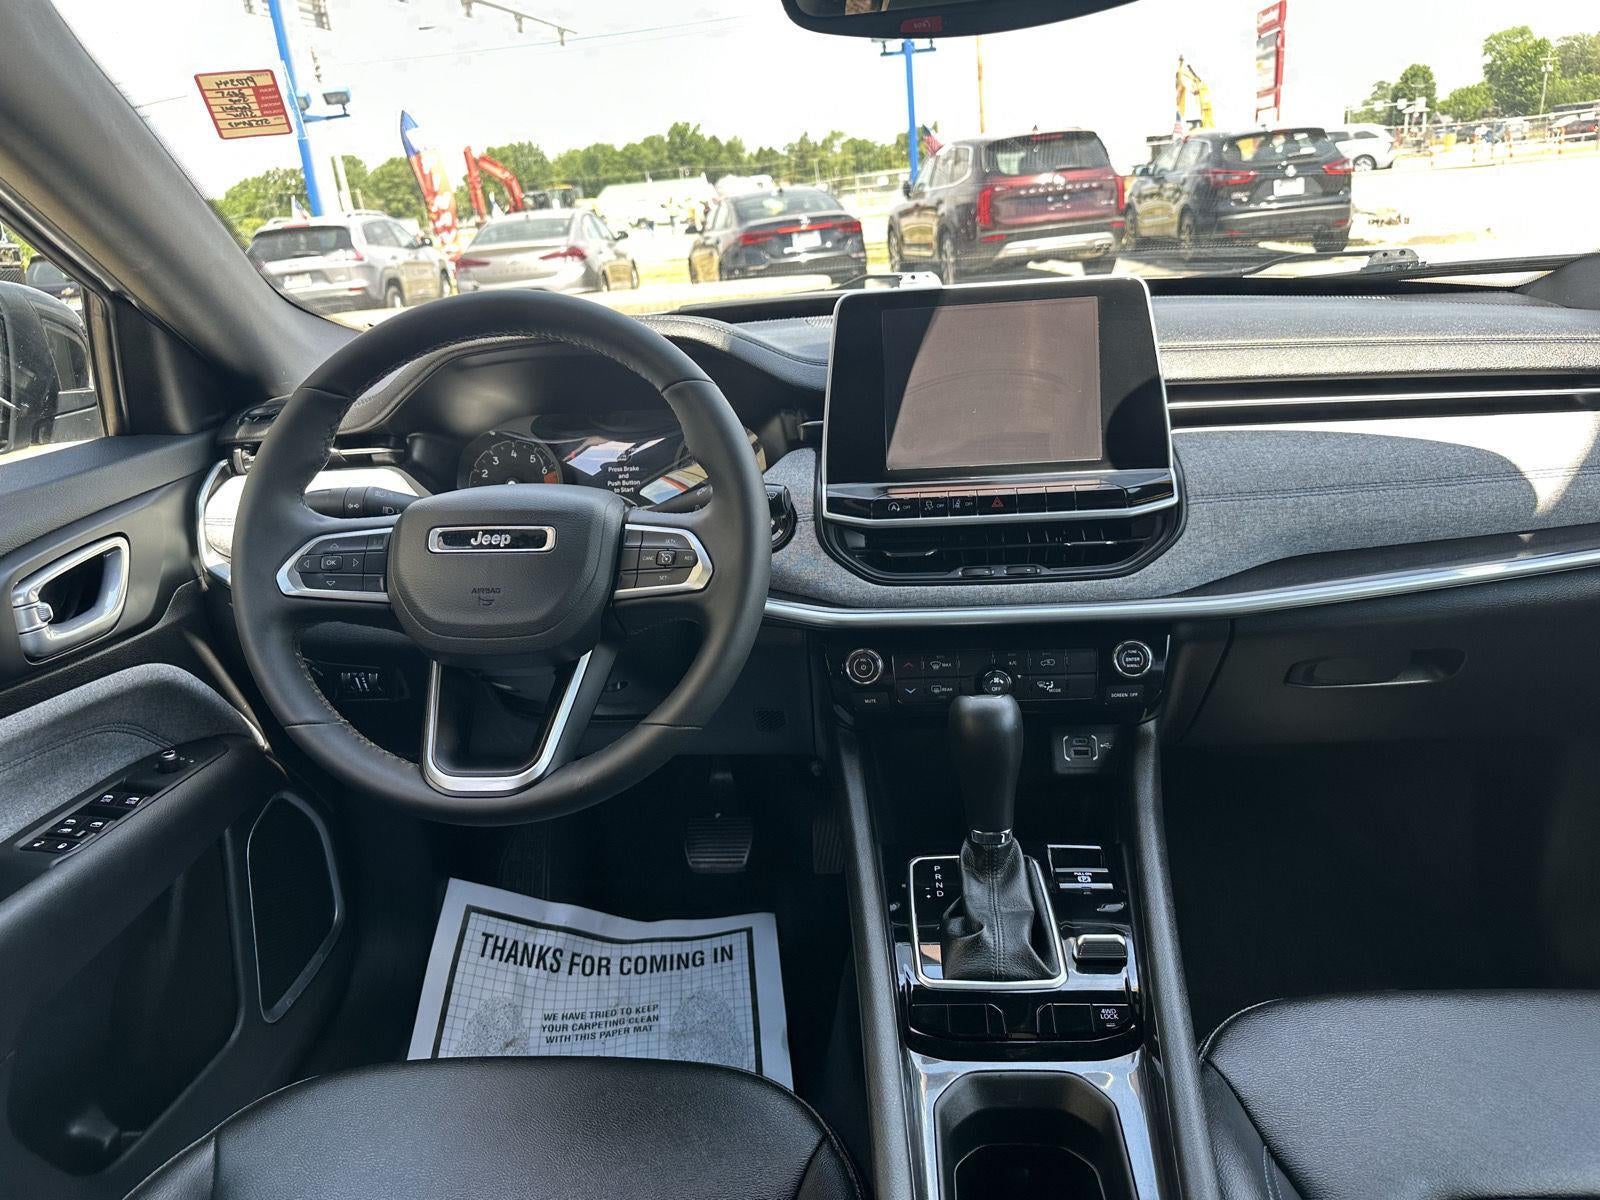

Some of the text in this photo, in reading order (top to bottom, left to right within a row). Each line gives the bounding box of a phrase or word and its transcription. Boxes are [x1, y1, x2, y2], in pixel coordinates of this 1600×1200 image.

[510, 449, 517, 458] 4
[530, 454, 536, 463] 5
[492, 456, 500, 465] 3
[482, 469, 488, 478] 2
[542, 466, 548, 474] 6
[470, 531, 511, 547] Jeep
[480, 932, 733, 976] THANKS FOR COMING IN
[544, 1004, 659, 1021] WE HAVE TRIED TO KEEP
[541, 1014, 659, 1032] YOUR CARPETING CLEAN
[545, 1024, 654, 1044] WITH THIS PAPER MAT
